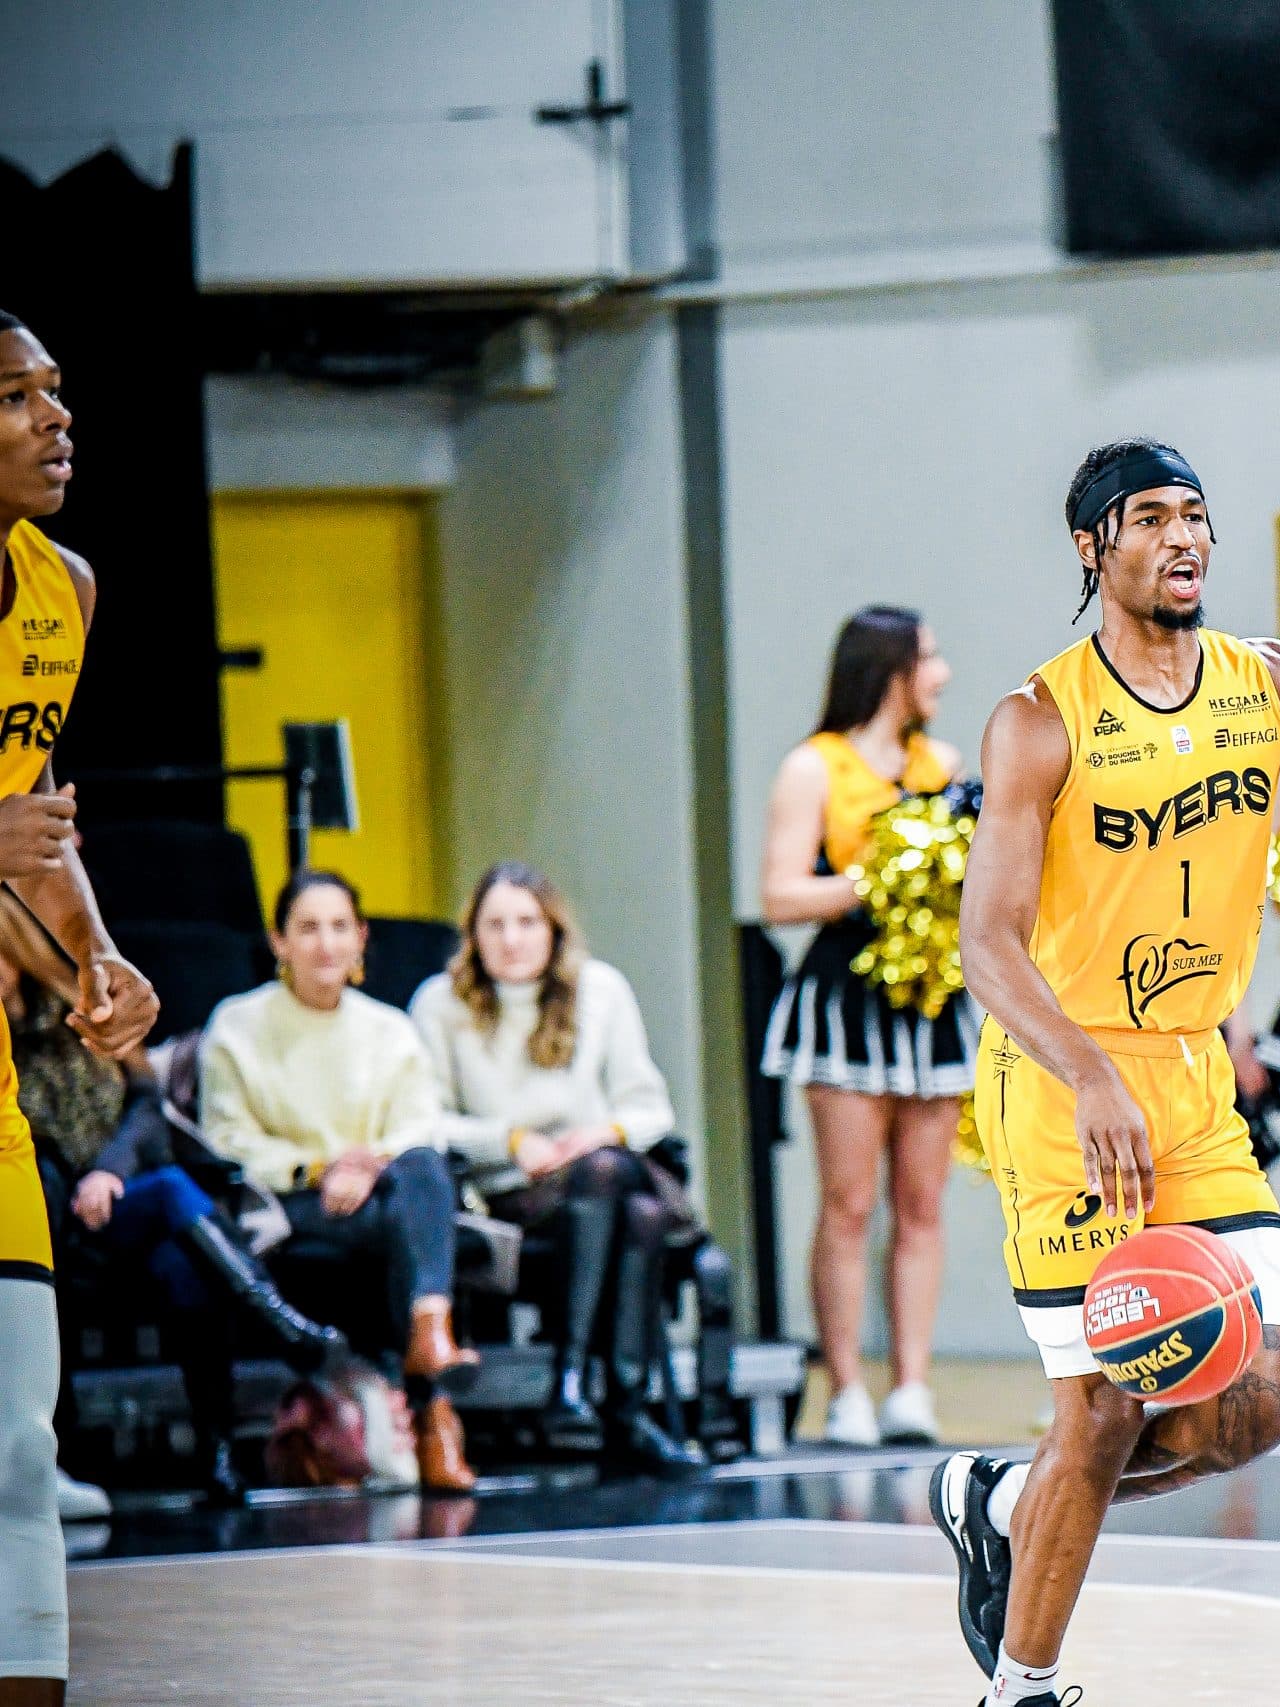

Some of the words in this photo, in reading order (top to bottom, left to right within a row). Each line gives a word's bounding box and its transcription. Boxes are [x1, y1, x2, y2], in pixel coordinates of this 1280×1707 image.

[1208, 691, 1268, 709] HECTARE
[0, 700, 62, 754] RS
[1093, 721, 1126, 736] PEAK
[1108, 750, 1141, 760] BOUCHES
[1094, 767, 1271, 853] BYERS
[1180, 860, 1190, 918] 1
[1172, 957, 1196, 971] SUR
[1040, 1224, 1128, 1256] IMERYS
[1098, 1330, 1193, 1383] SPALDIN
